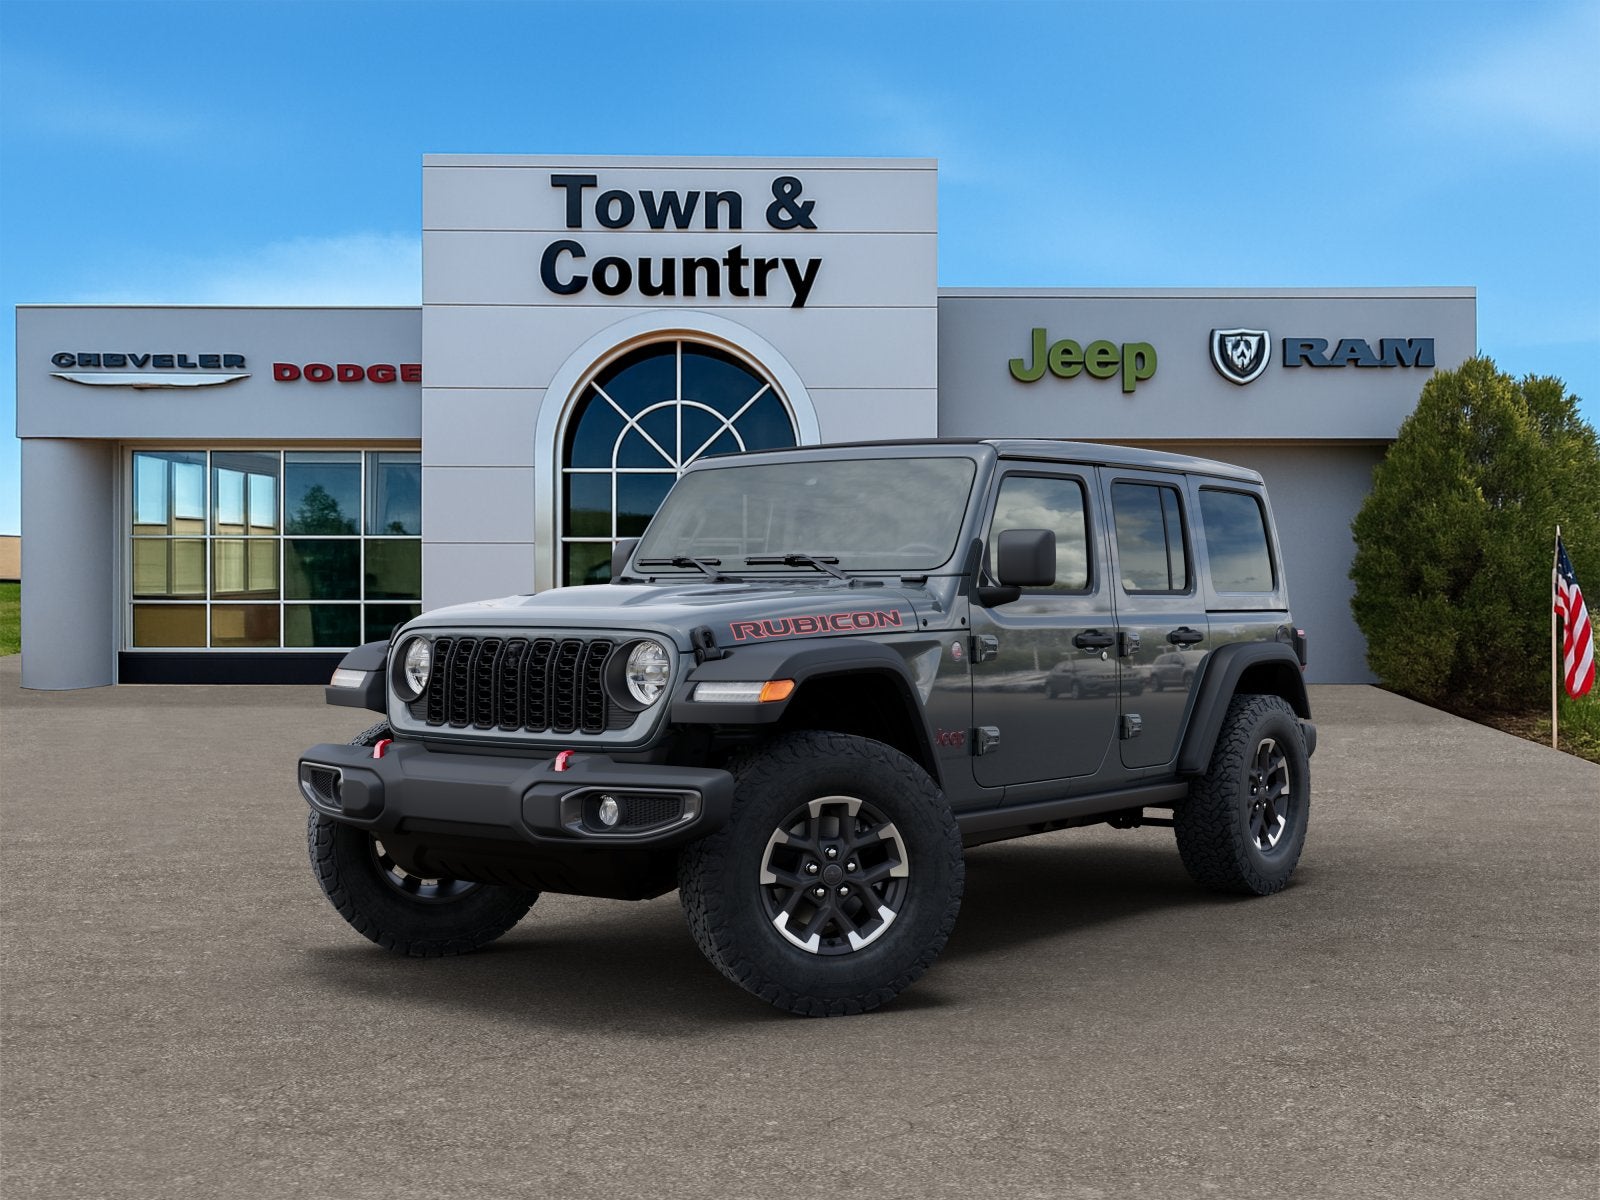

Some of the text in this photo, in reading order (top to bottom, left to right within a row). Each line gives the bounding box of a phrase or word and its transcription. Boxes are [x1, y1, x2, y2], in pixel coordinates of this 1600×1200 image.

[551, 174, 818, 230] Town &
[539, 240, 822, 308] Country
[273, 363, 422, 383] DODGE
[1009, 328, 1158, 393] Jeep
[1283, 338, 1435, 368] RAM
[730, 610, 903, 641] RUBICON
